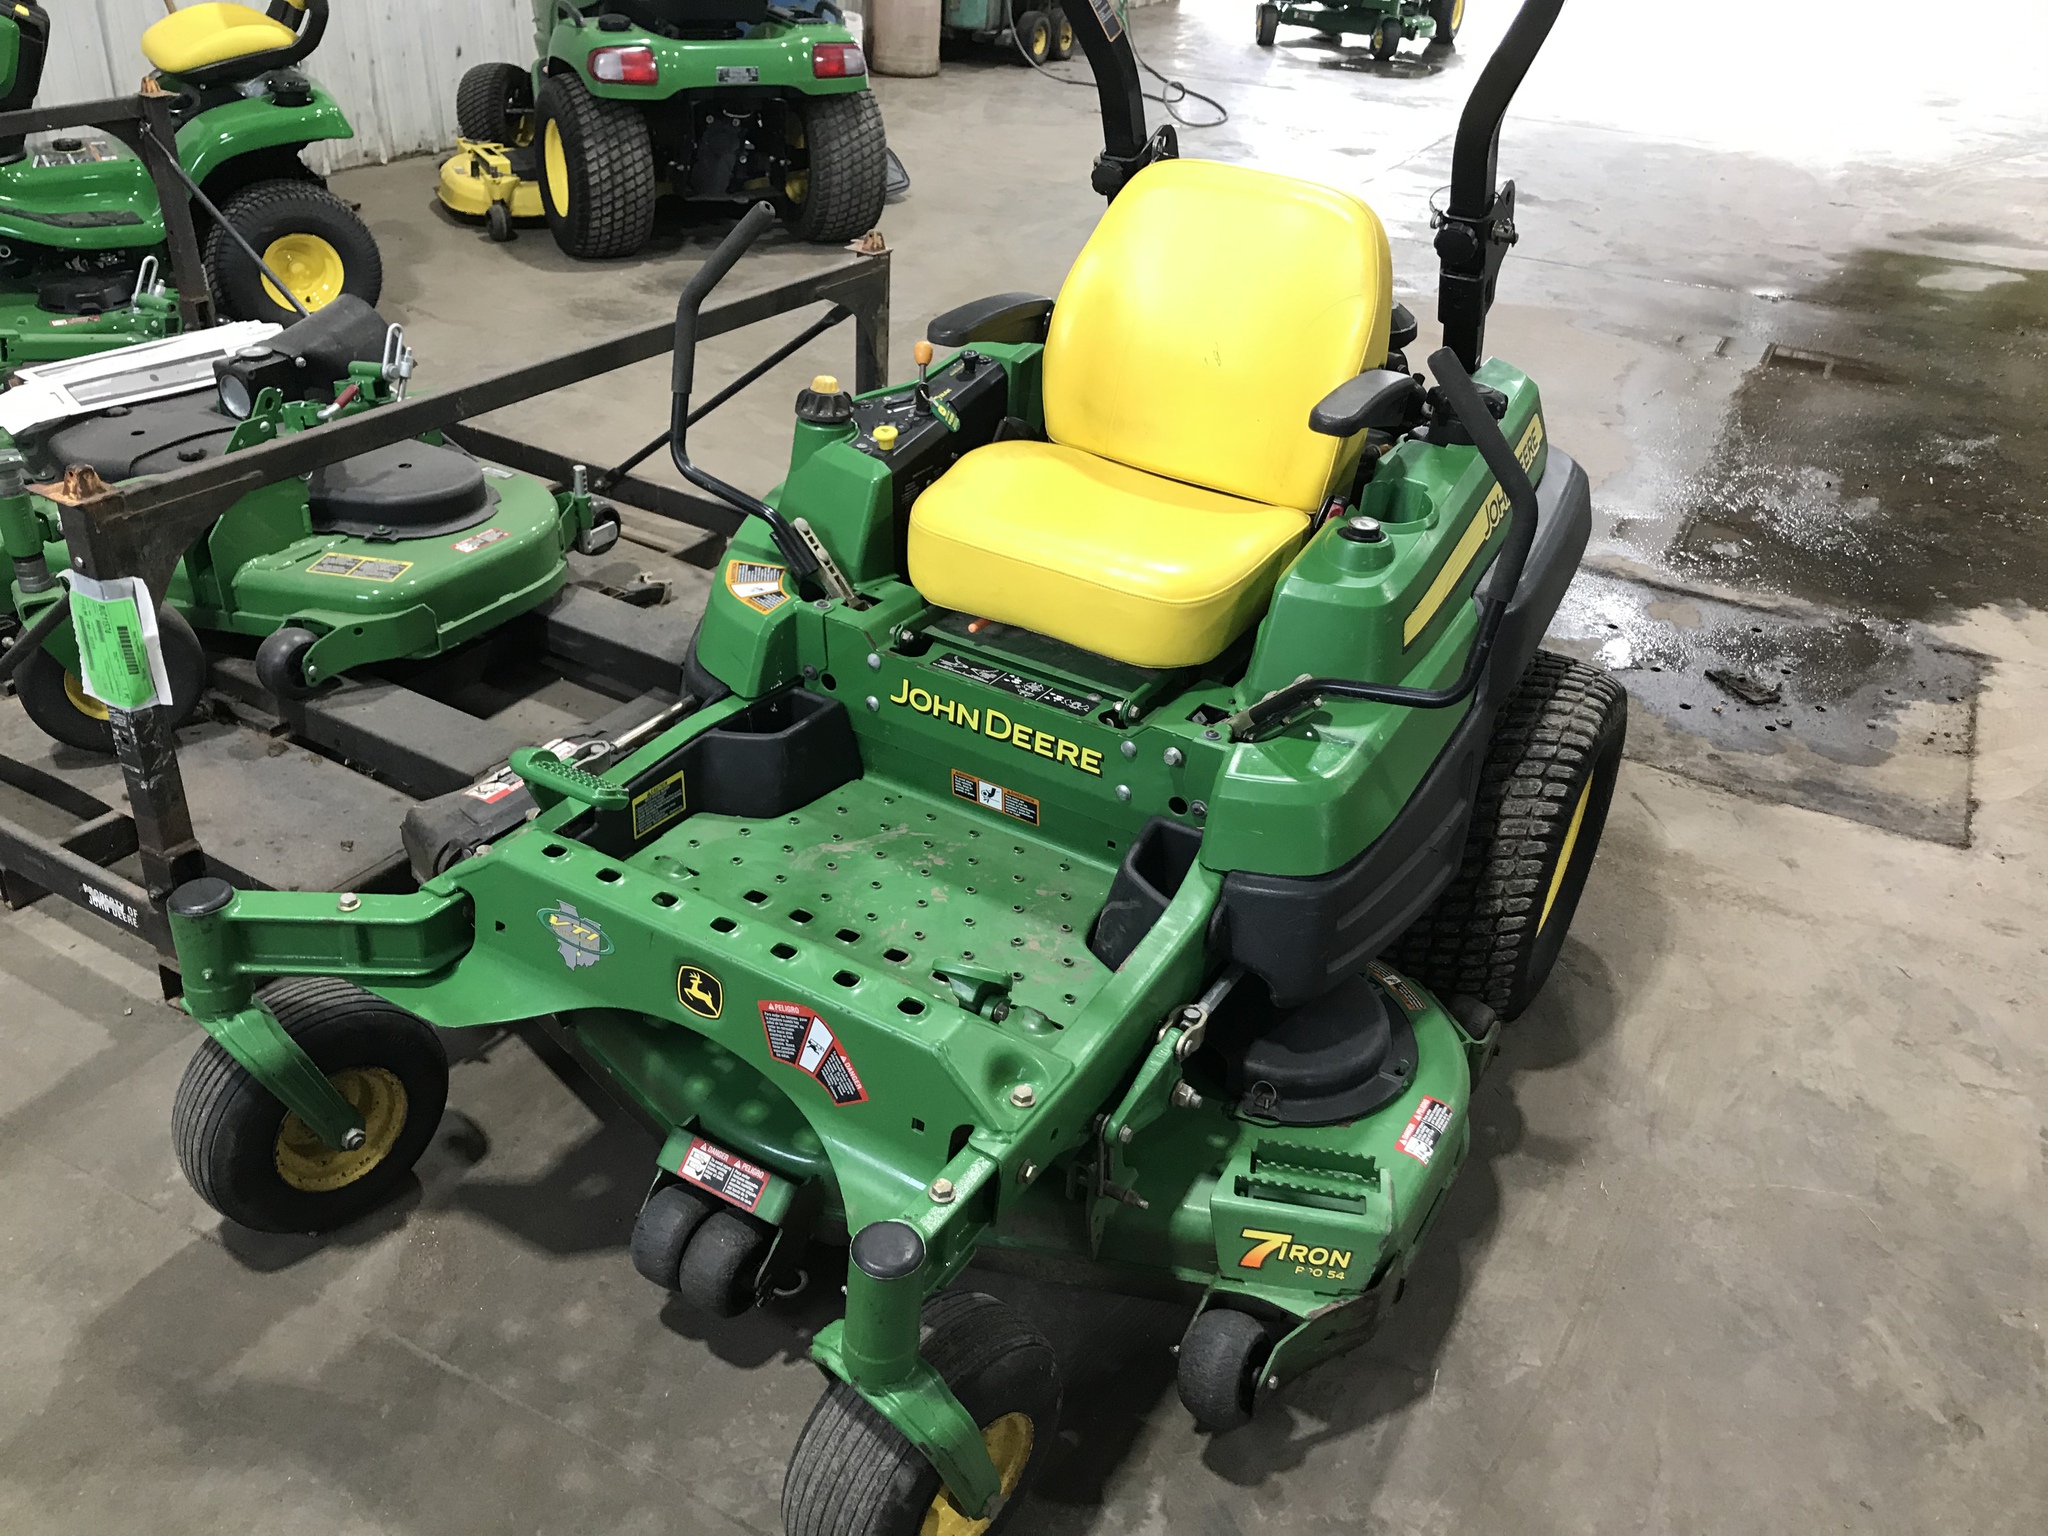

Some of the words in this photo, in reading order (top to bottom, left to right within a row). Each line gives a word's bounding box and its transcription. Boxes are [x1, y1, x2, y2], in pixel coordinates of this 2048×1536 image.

[1485, 493, 1510, 537] JOH
[890, 679, 980, 732] JOHN
[985, 708, 1104, 776] DEERE
[127, 906, 138, 917] OF
[774, 1003, 799, 1014] PELIGRO
[845, 1063, 862, 1089] DANGER
[708, 1145, 729, 1160] DANGER
[742, 1162, 764, 1178] PELIGRO
[1326, 1270, 1345, 1280] 54
